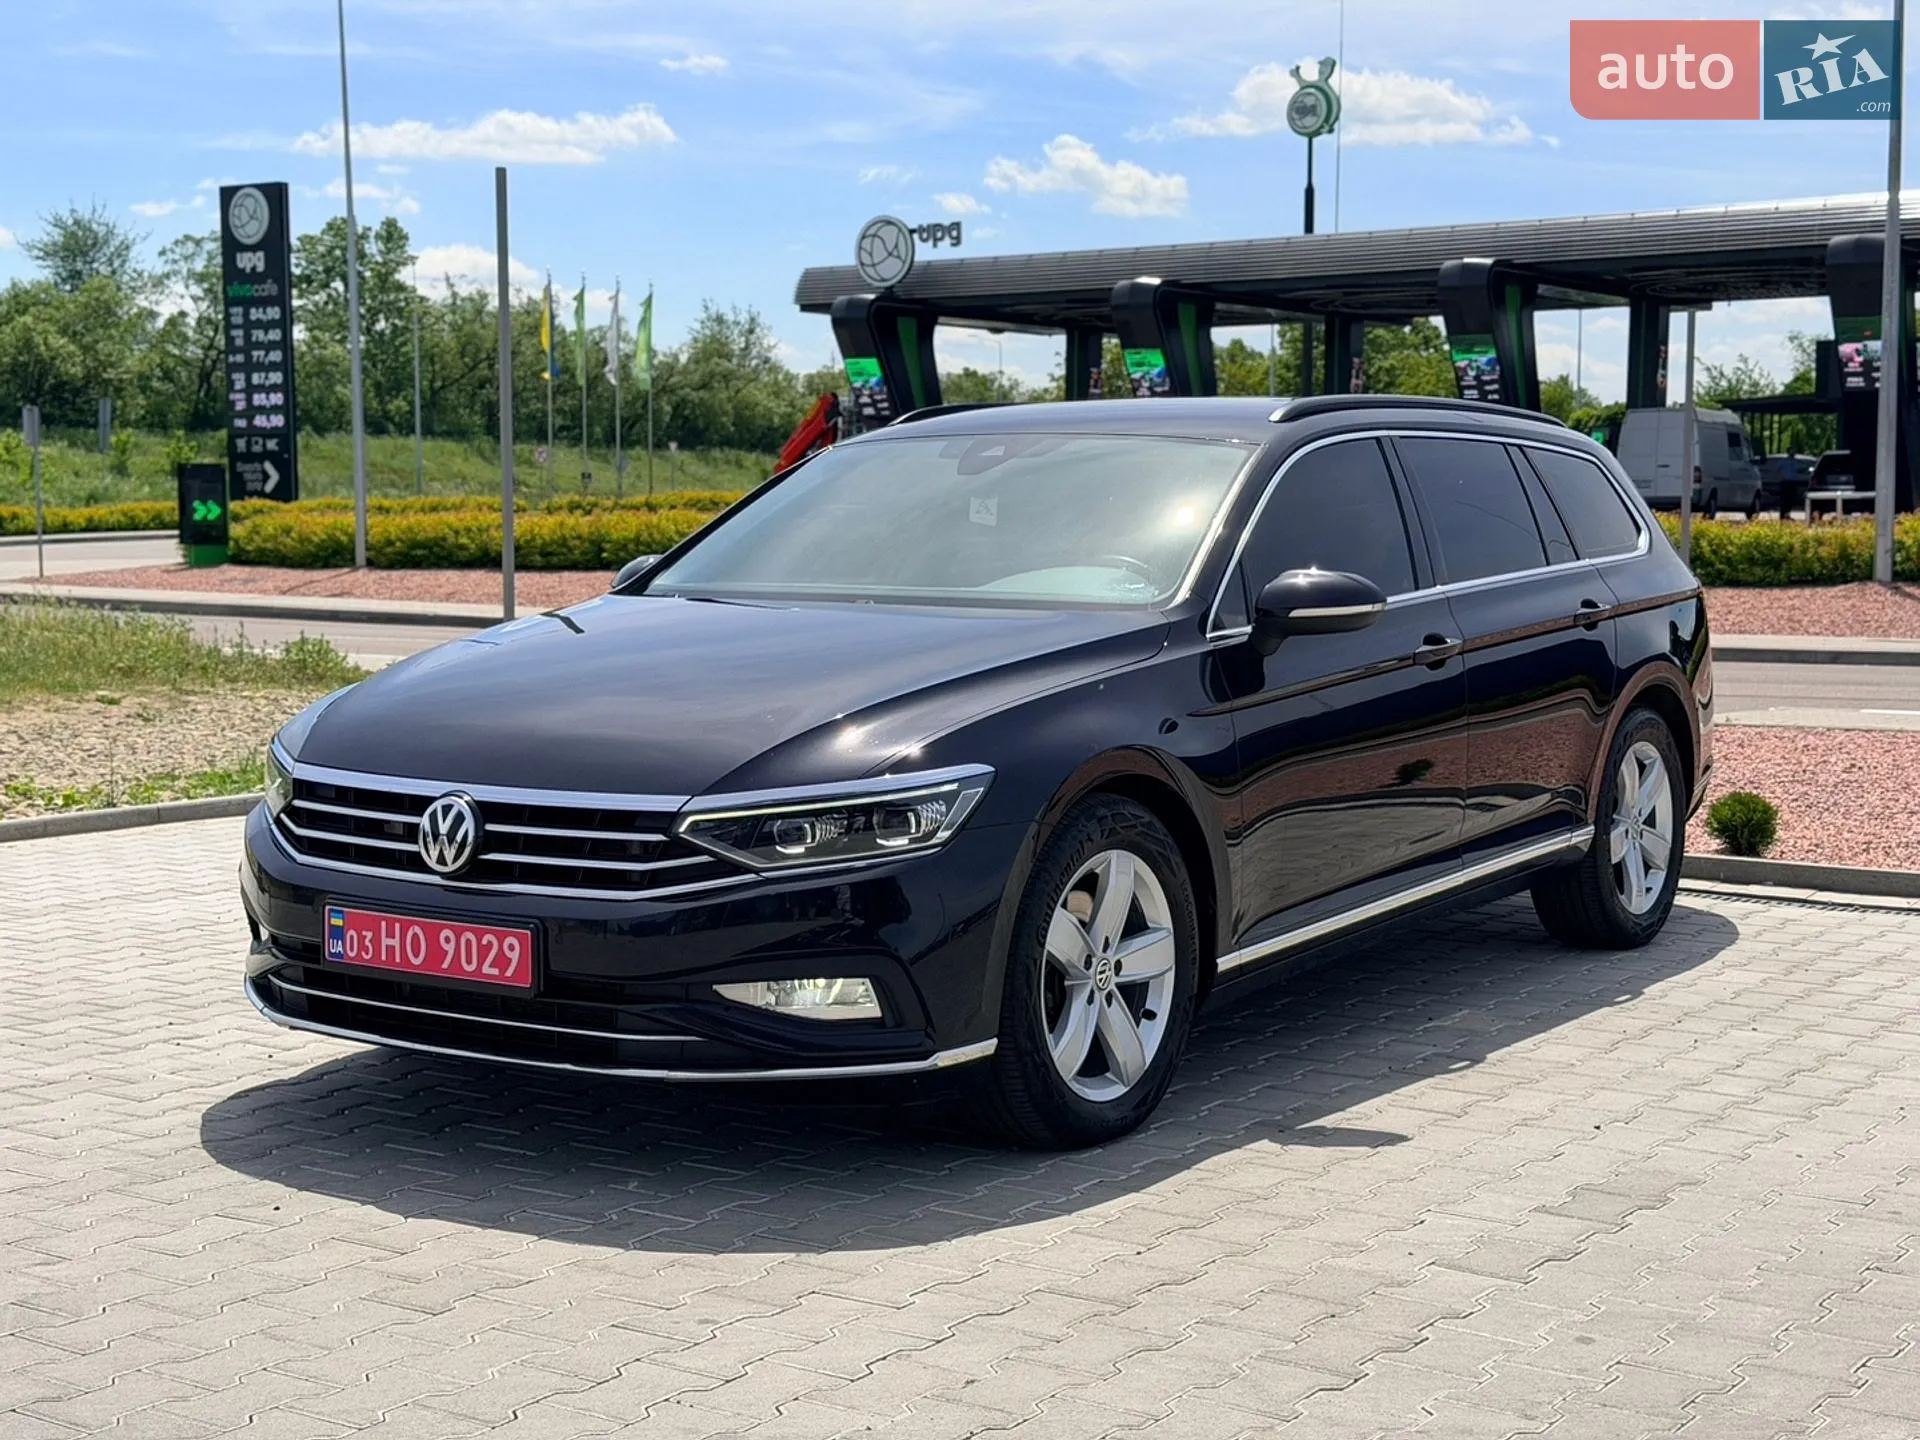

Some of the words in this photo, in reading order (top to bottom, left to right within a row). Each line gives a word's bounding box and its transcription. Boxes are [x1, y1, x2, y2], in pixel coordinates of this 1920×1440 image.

[917, 221, 962, 248] upg
[235, 251, 266, 274] upg
[329, 938, 344, 954] UA
[346, 929, 373, 960] 03
[439, 928, 521, 977] 9029
